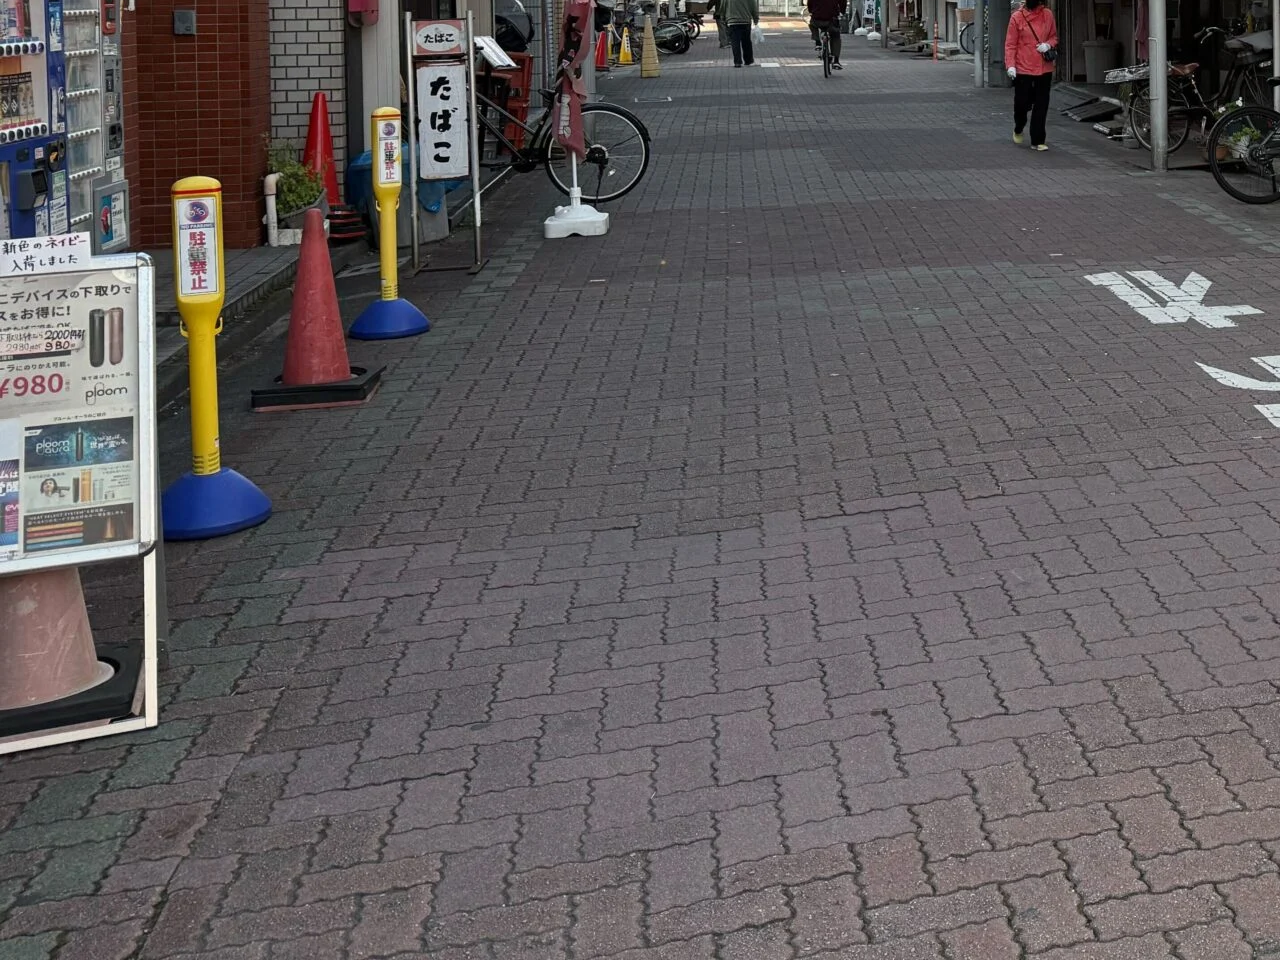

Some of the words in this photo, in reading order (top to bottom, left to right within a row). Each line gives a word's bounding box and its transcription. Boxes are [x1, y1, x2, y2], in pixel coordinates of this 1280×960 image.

[424, 33, 454, 43] たばこ
[430, 76, 458, 163] たばこ
[11, 255, 78, 272] 入荷しました
[85, 382, 128, 406] ploom
[36, 437, 70, 456] ploom
[44, 445, 70, 454] aura
